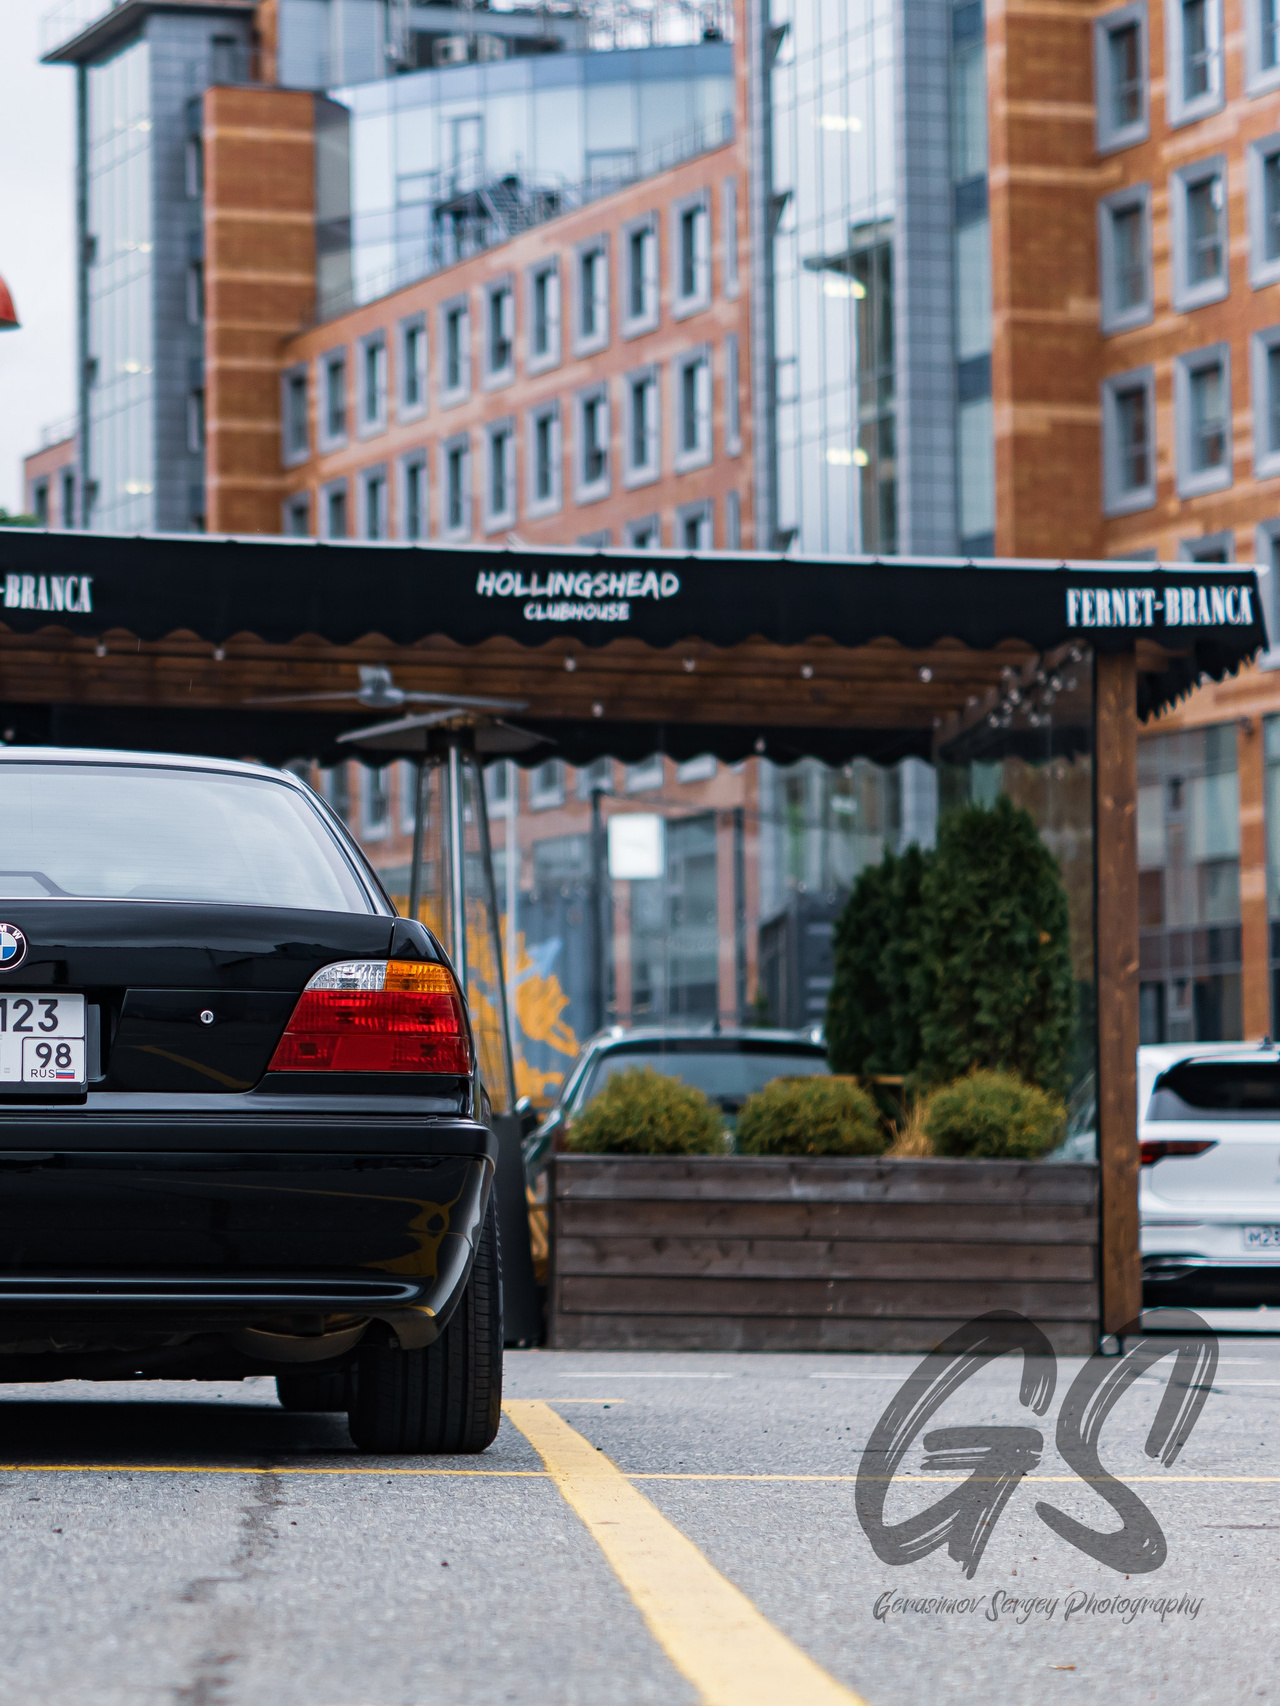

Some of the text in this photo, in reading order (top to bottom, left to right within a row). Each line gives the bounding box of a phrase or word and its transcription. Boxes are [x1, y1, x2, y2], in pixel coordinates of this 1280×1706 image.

[475, 570, 680, 600] HOLLINGSHEAD
[523, 602, 630, 621] CLUBHOUSE
[1066, 585, 1254, 627] FERNET-BRANCA
[35, 1042, 72, 1068] 98
[30, 1069, 56, 1079] RUS
